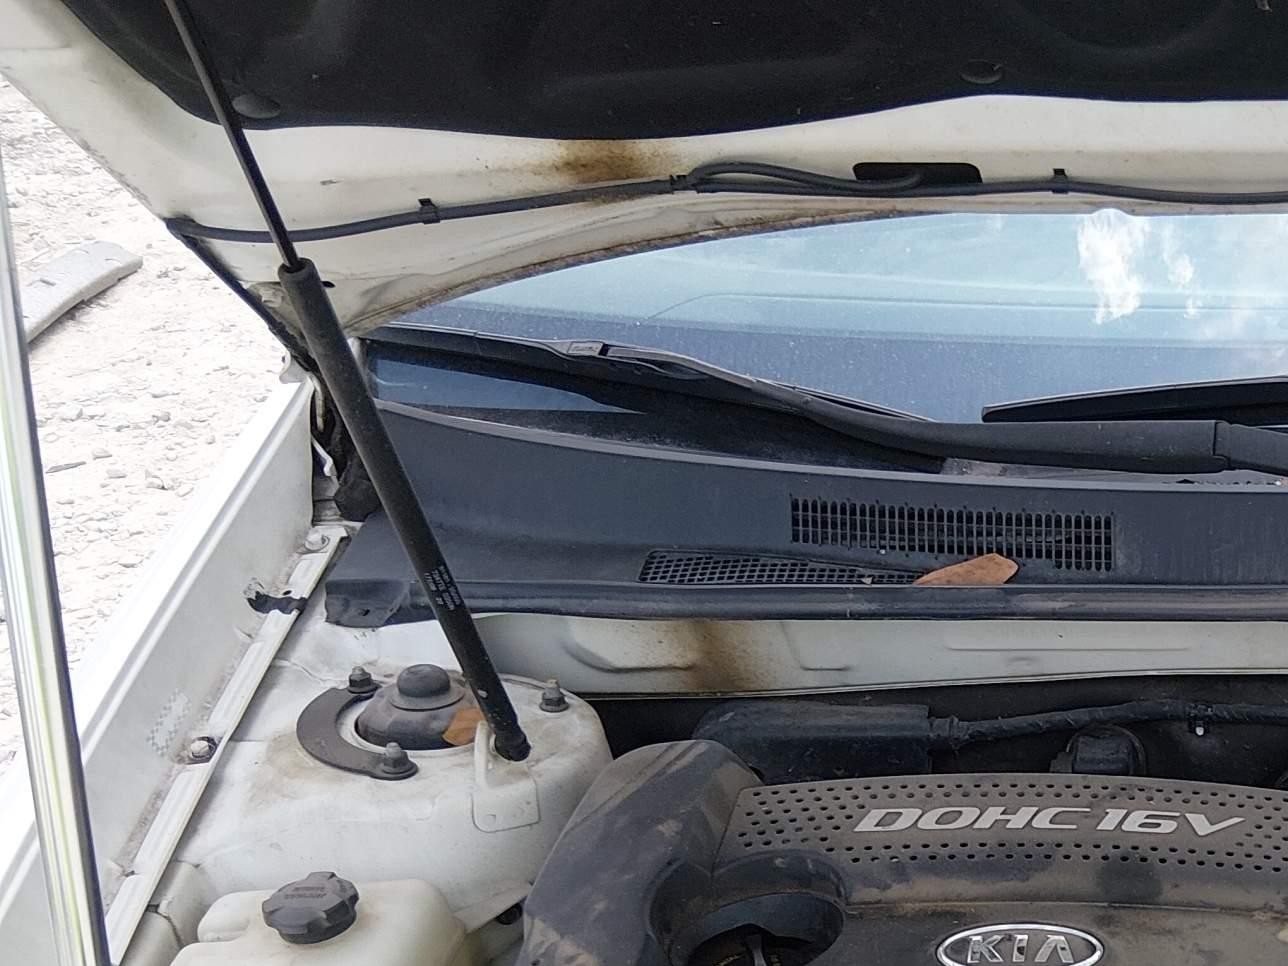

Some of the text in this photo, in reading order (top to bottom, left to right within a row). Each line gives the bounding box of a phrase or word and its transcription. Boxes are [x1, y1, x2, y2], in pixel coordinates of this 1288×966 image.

[853, 806, 1245, 836] DOHC 16V
[966, 934, 1074, 963] KIA
